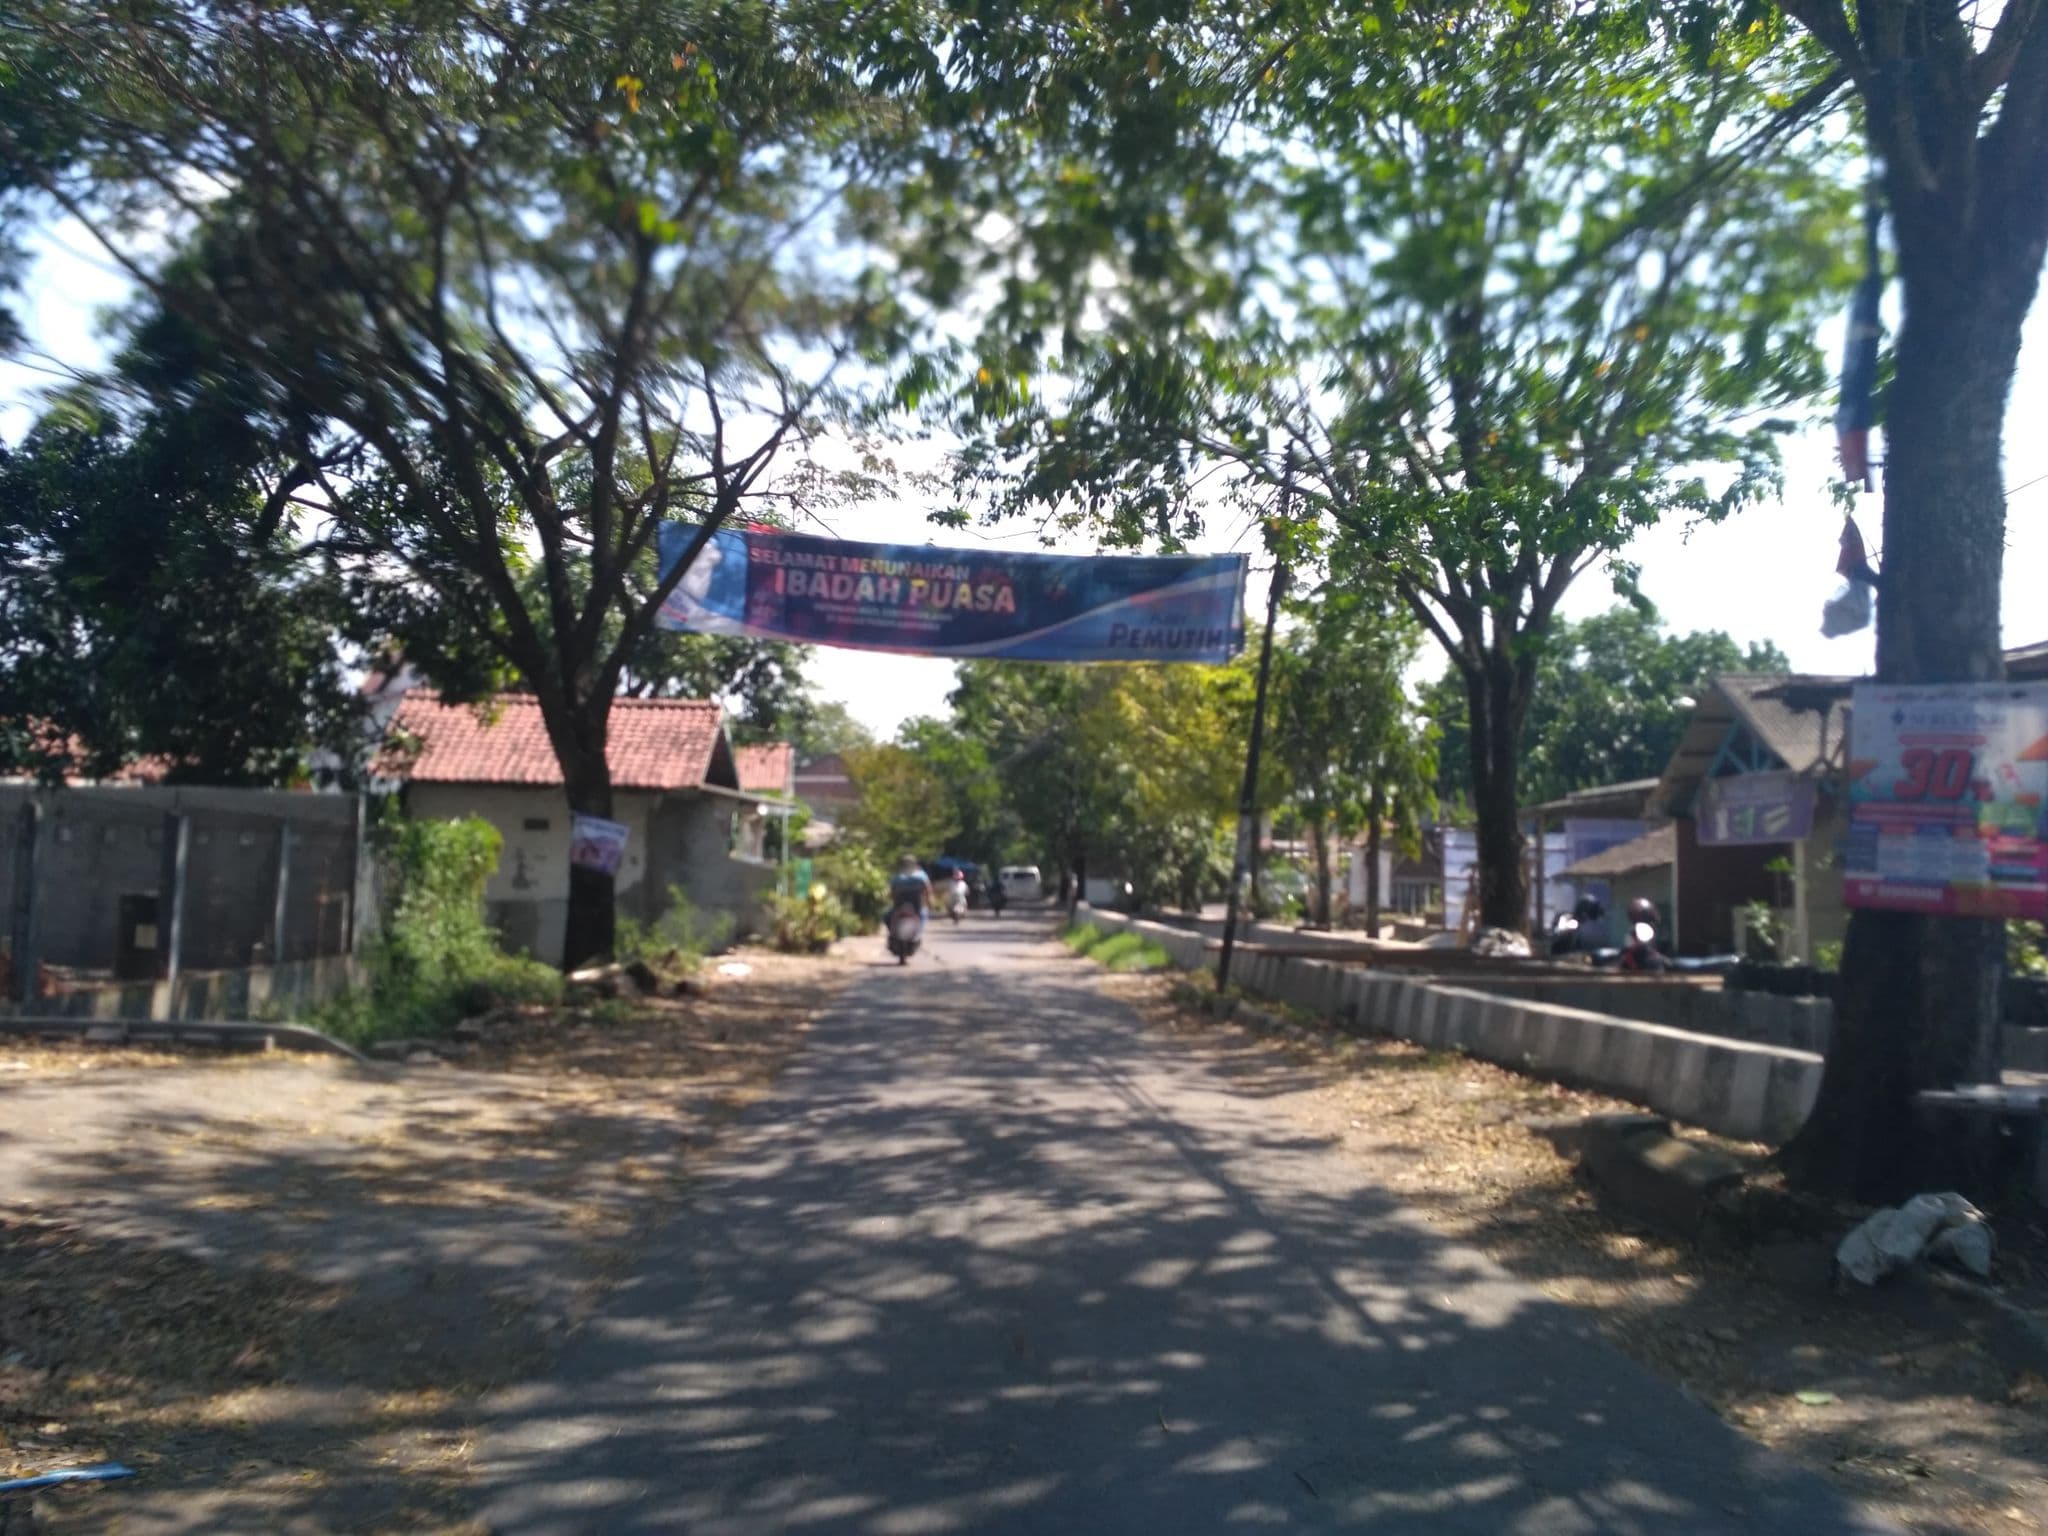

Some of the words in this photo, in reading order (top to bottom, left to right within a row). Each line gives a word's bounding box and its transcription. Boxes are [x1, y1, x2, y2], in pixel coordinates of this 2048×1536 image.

[750, 547, 837, 571] SELAMAT
[775, 566, 900, 605] IBADAH
[908, 579, 1016, 613] PUASA
